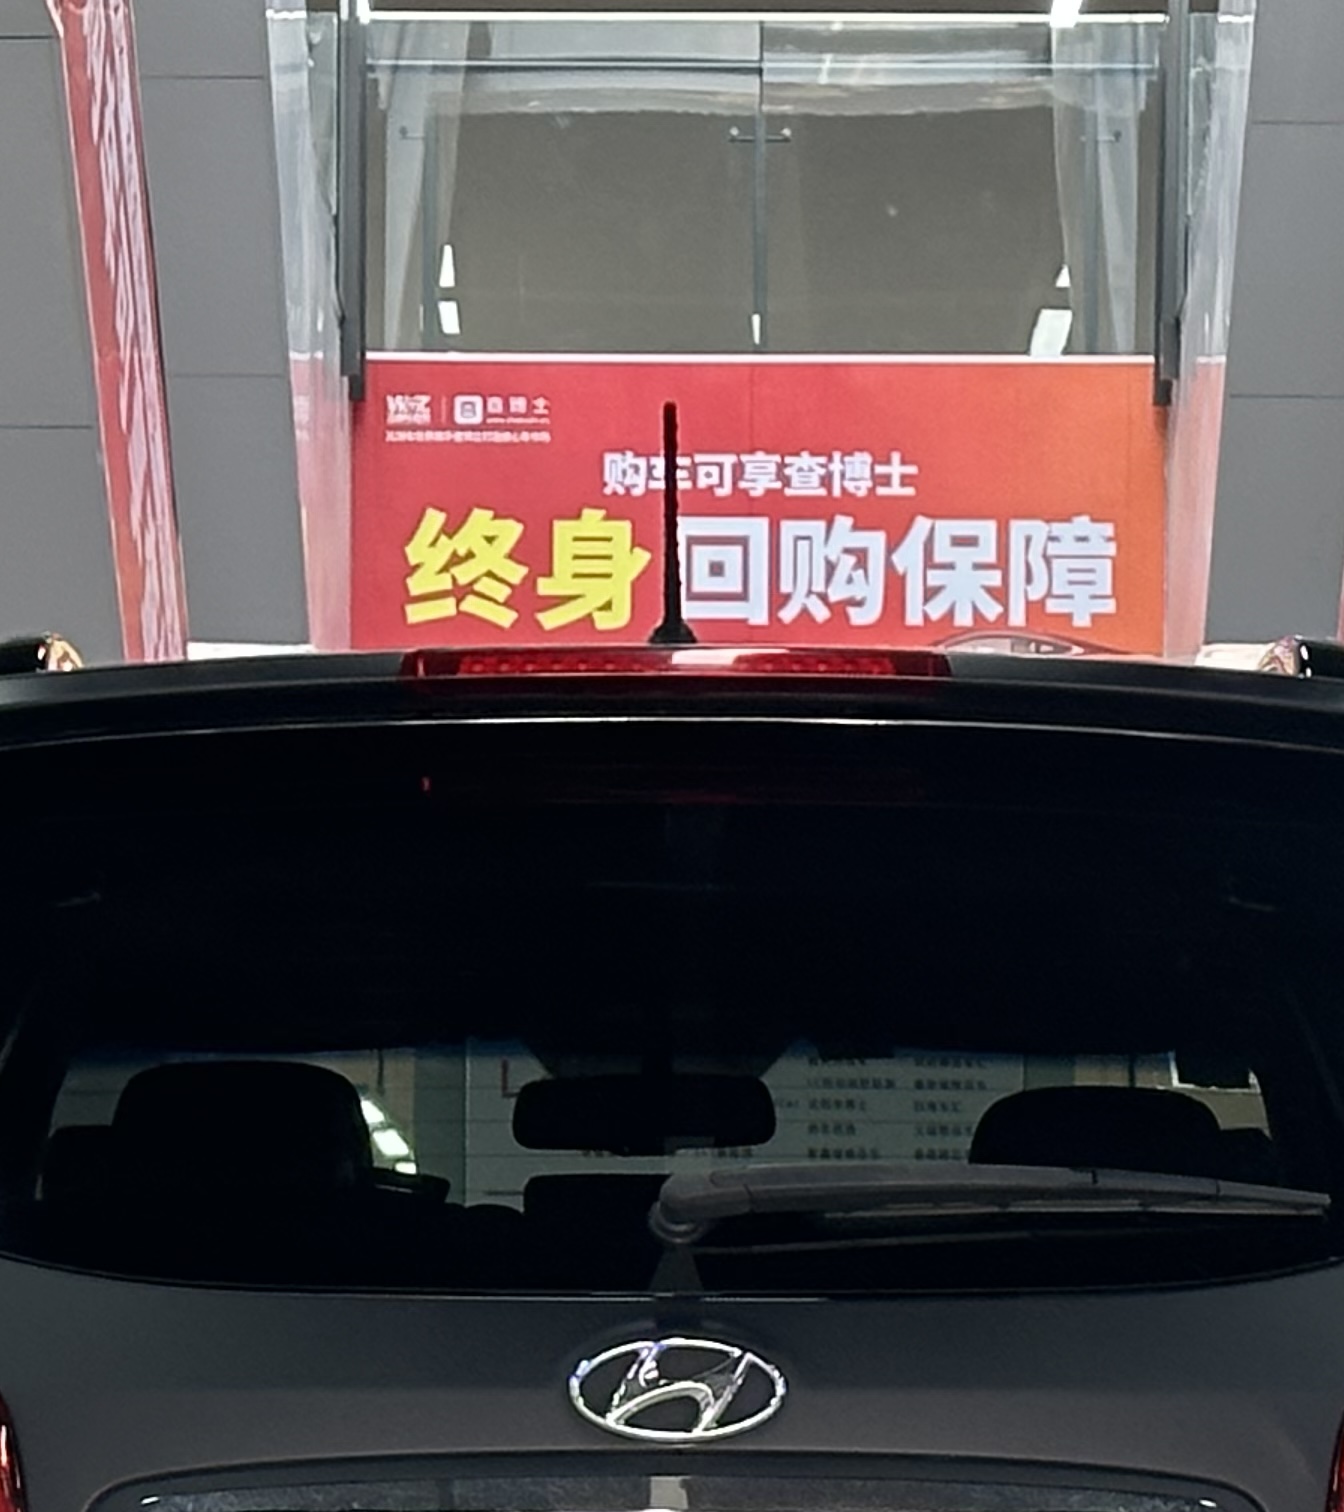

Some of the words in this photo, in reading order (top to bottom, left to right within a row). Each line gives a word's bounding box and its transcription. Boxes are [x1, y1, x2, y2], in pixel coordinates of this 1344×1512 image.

[602, 450, 919, 497] 购车可享查博士
[404, 506, 1117, 631] 终身回购保障
